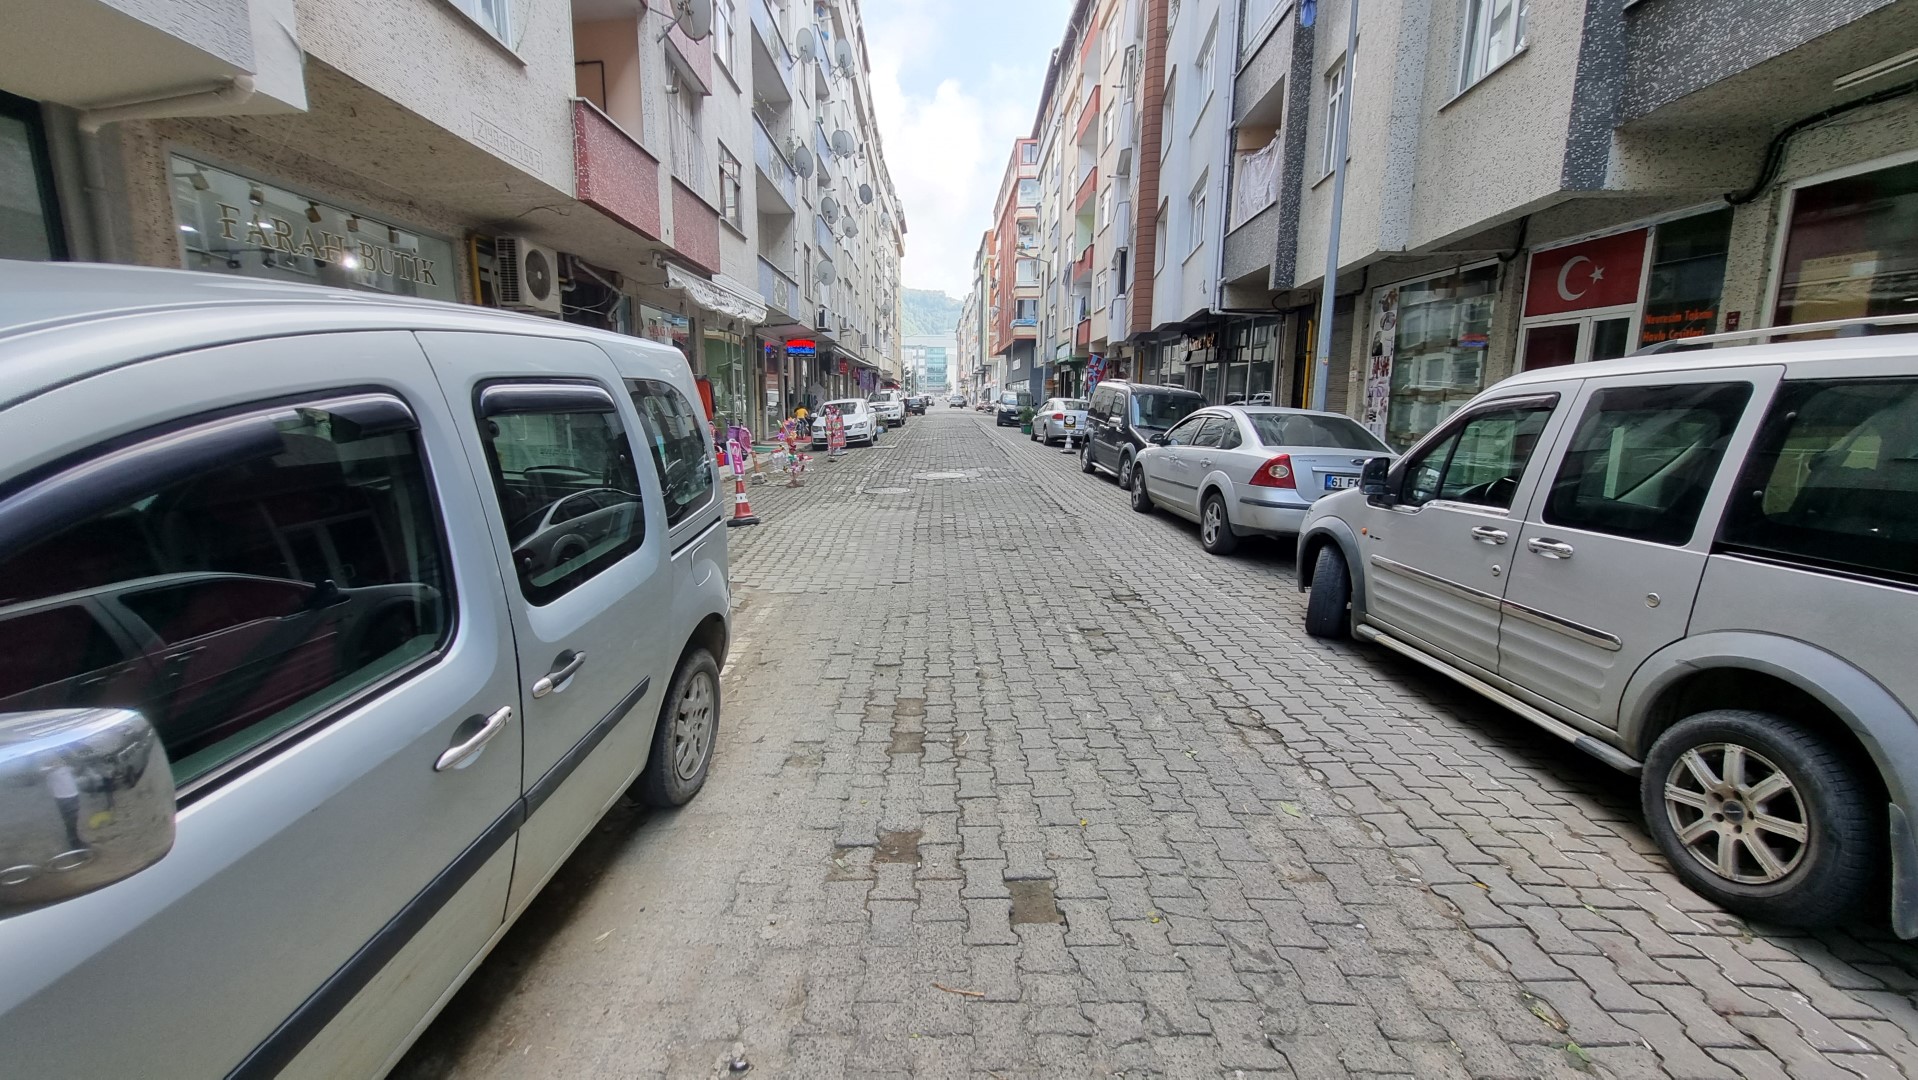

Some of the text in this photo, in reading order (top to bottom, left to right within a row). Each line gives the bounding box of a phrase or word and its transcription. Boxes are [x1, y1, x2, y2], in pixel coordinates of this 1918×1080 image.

[216, 202, 438, 287] FARAH BUTİK
[1331, 477, 1343, 487] 61
